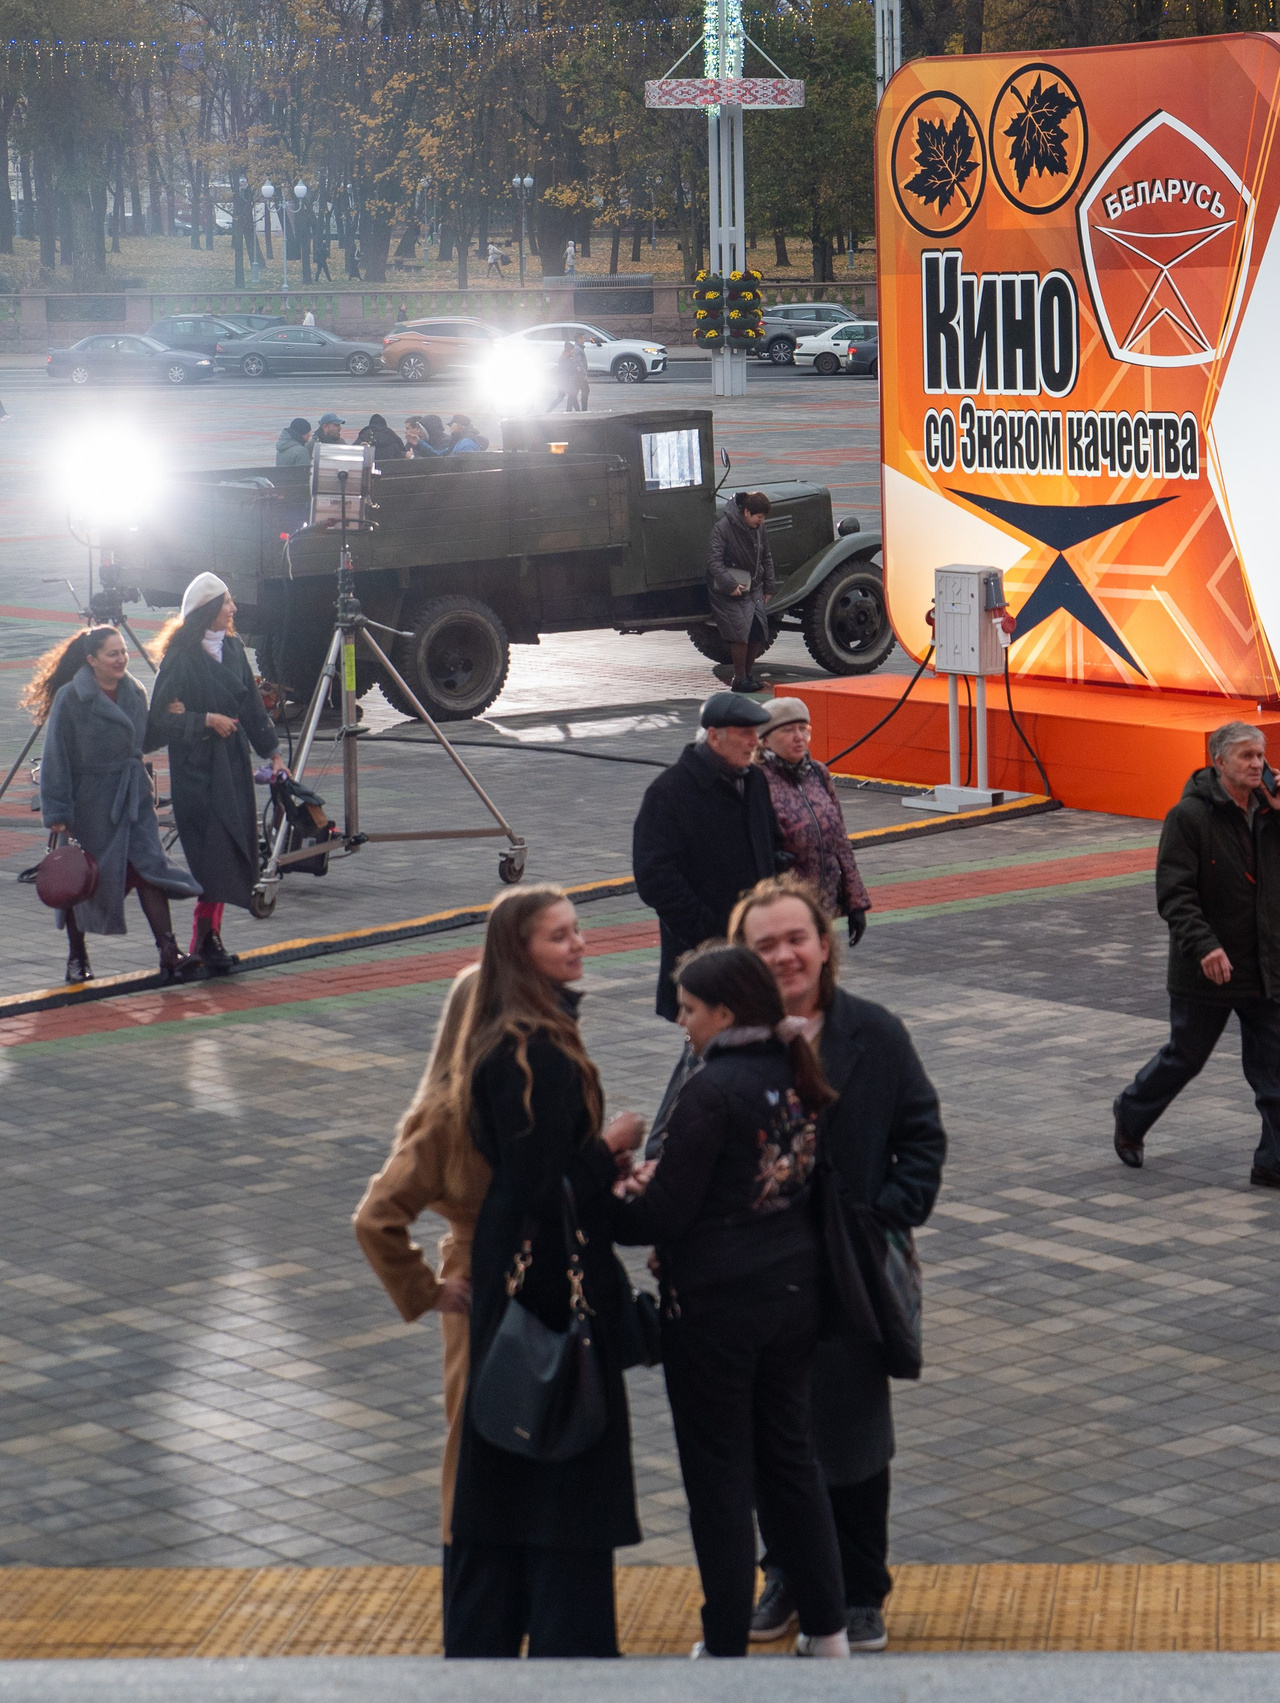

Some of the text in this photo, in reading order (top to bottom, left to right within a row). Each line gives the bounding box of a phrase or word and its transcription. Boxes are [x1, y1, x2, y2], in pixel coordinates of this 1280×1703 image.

[1103, 178, 1226, 220] БЕЛАРУСЬ
[923, 253, 1077, 396] Кино
[924, 399, 1198, 477] со Знаком качества
